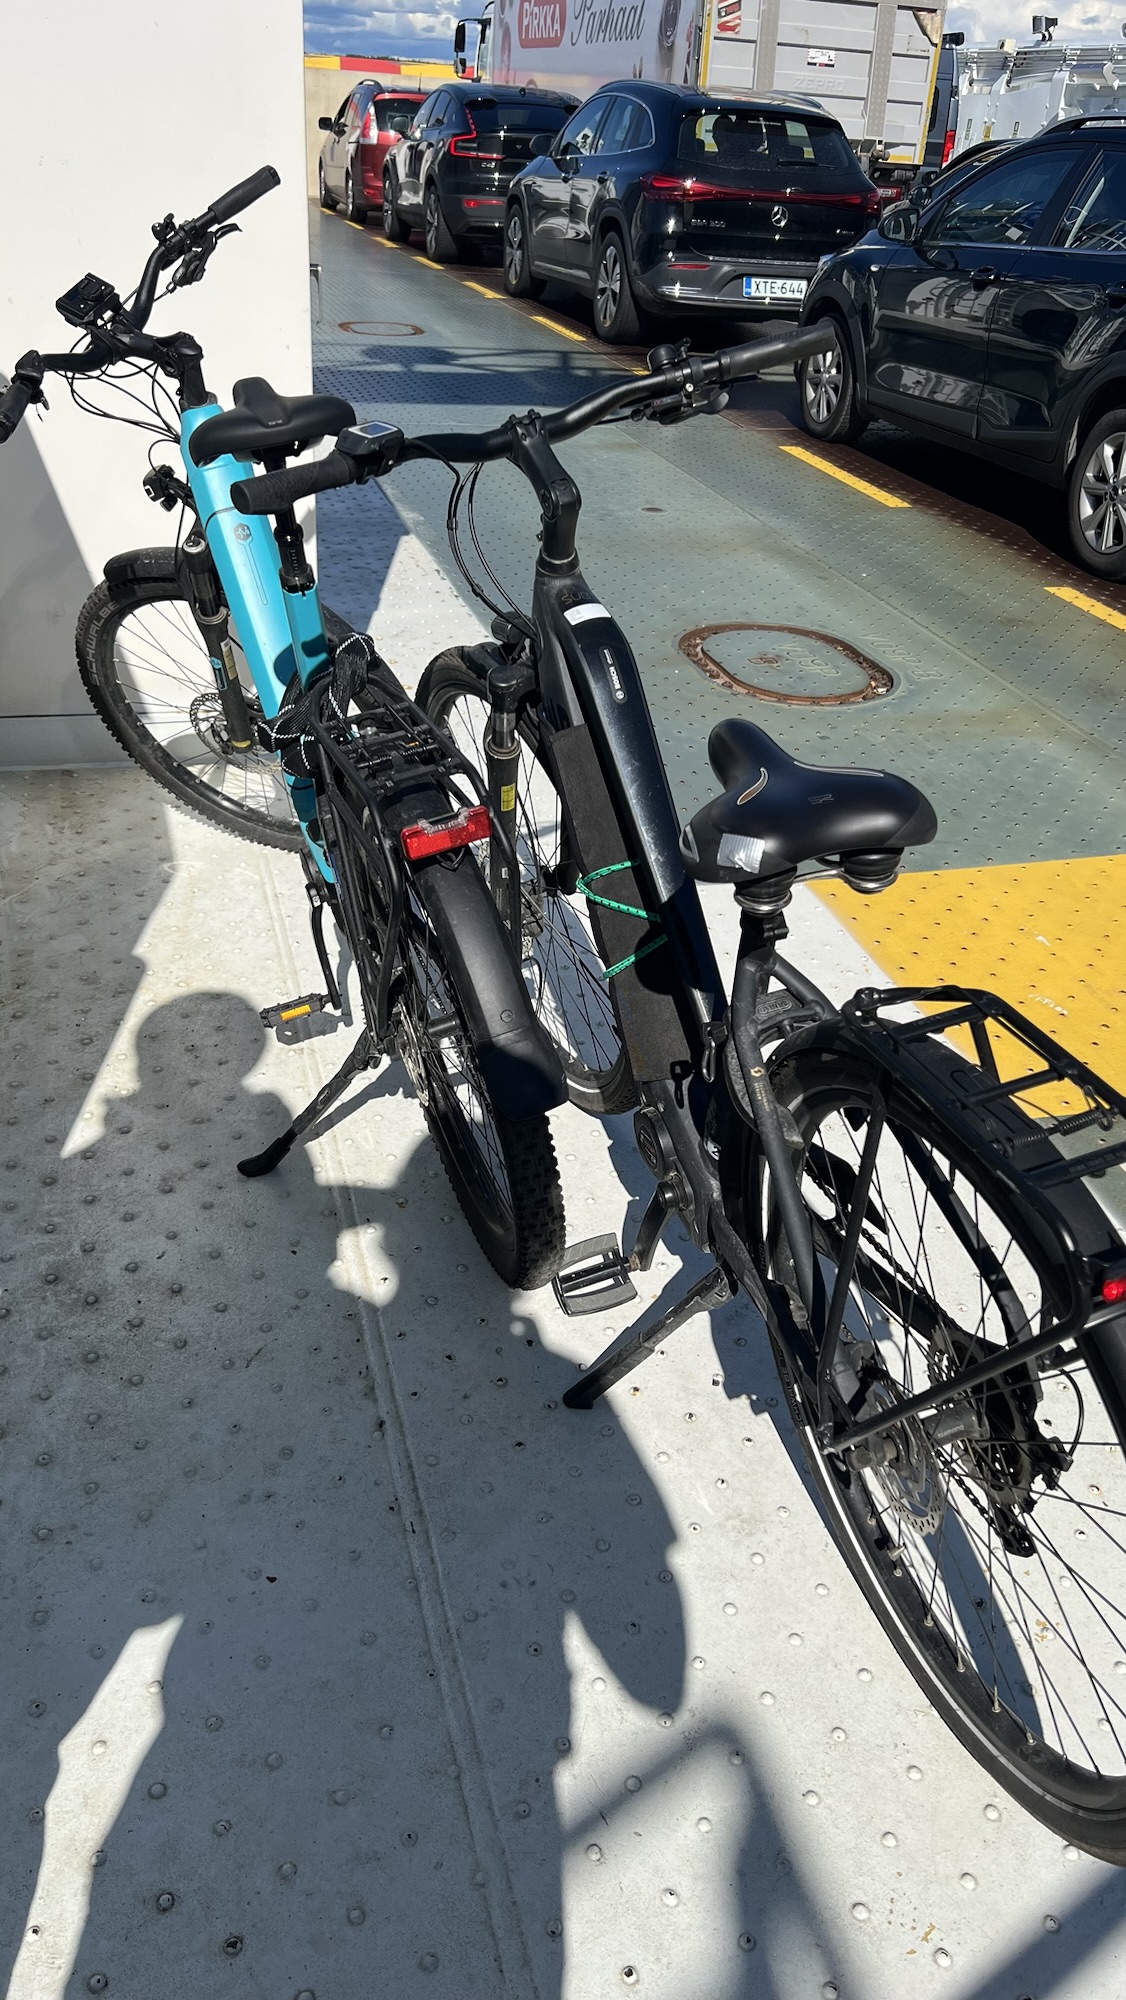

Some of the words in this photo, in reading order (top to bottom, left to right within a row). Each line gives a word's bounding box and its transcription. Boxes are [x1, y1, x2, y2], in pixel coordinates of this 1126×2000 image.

[794, 76, 845, 92] ZEPRO
[754, 280, 803, 296] XTE-644
[86, 600, 120, 687] SCHWALBE
